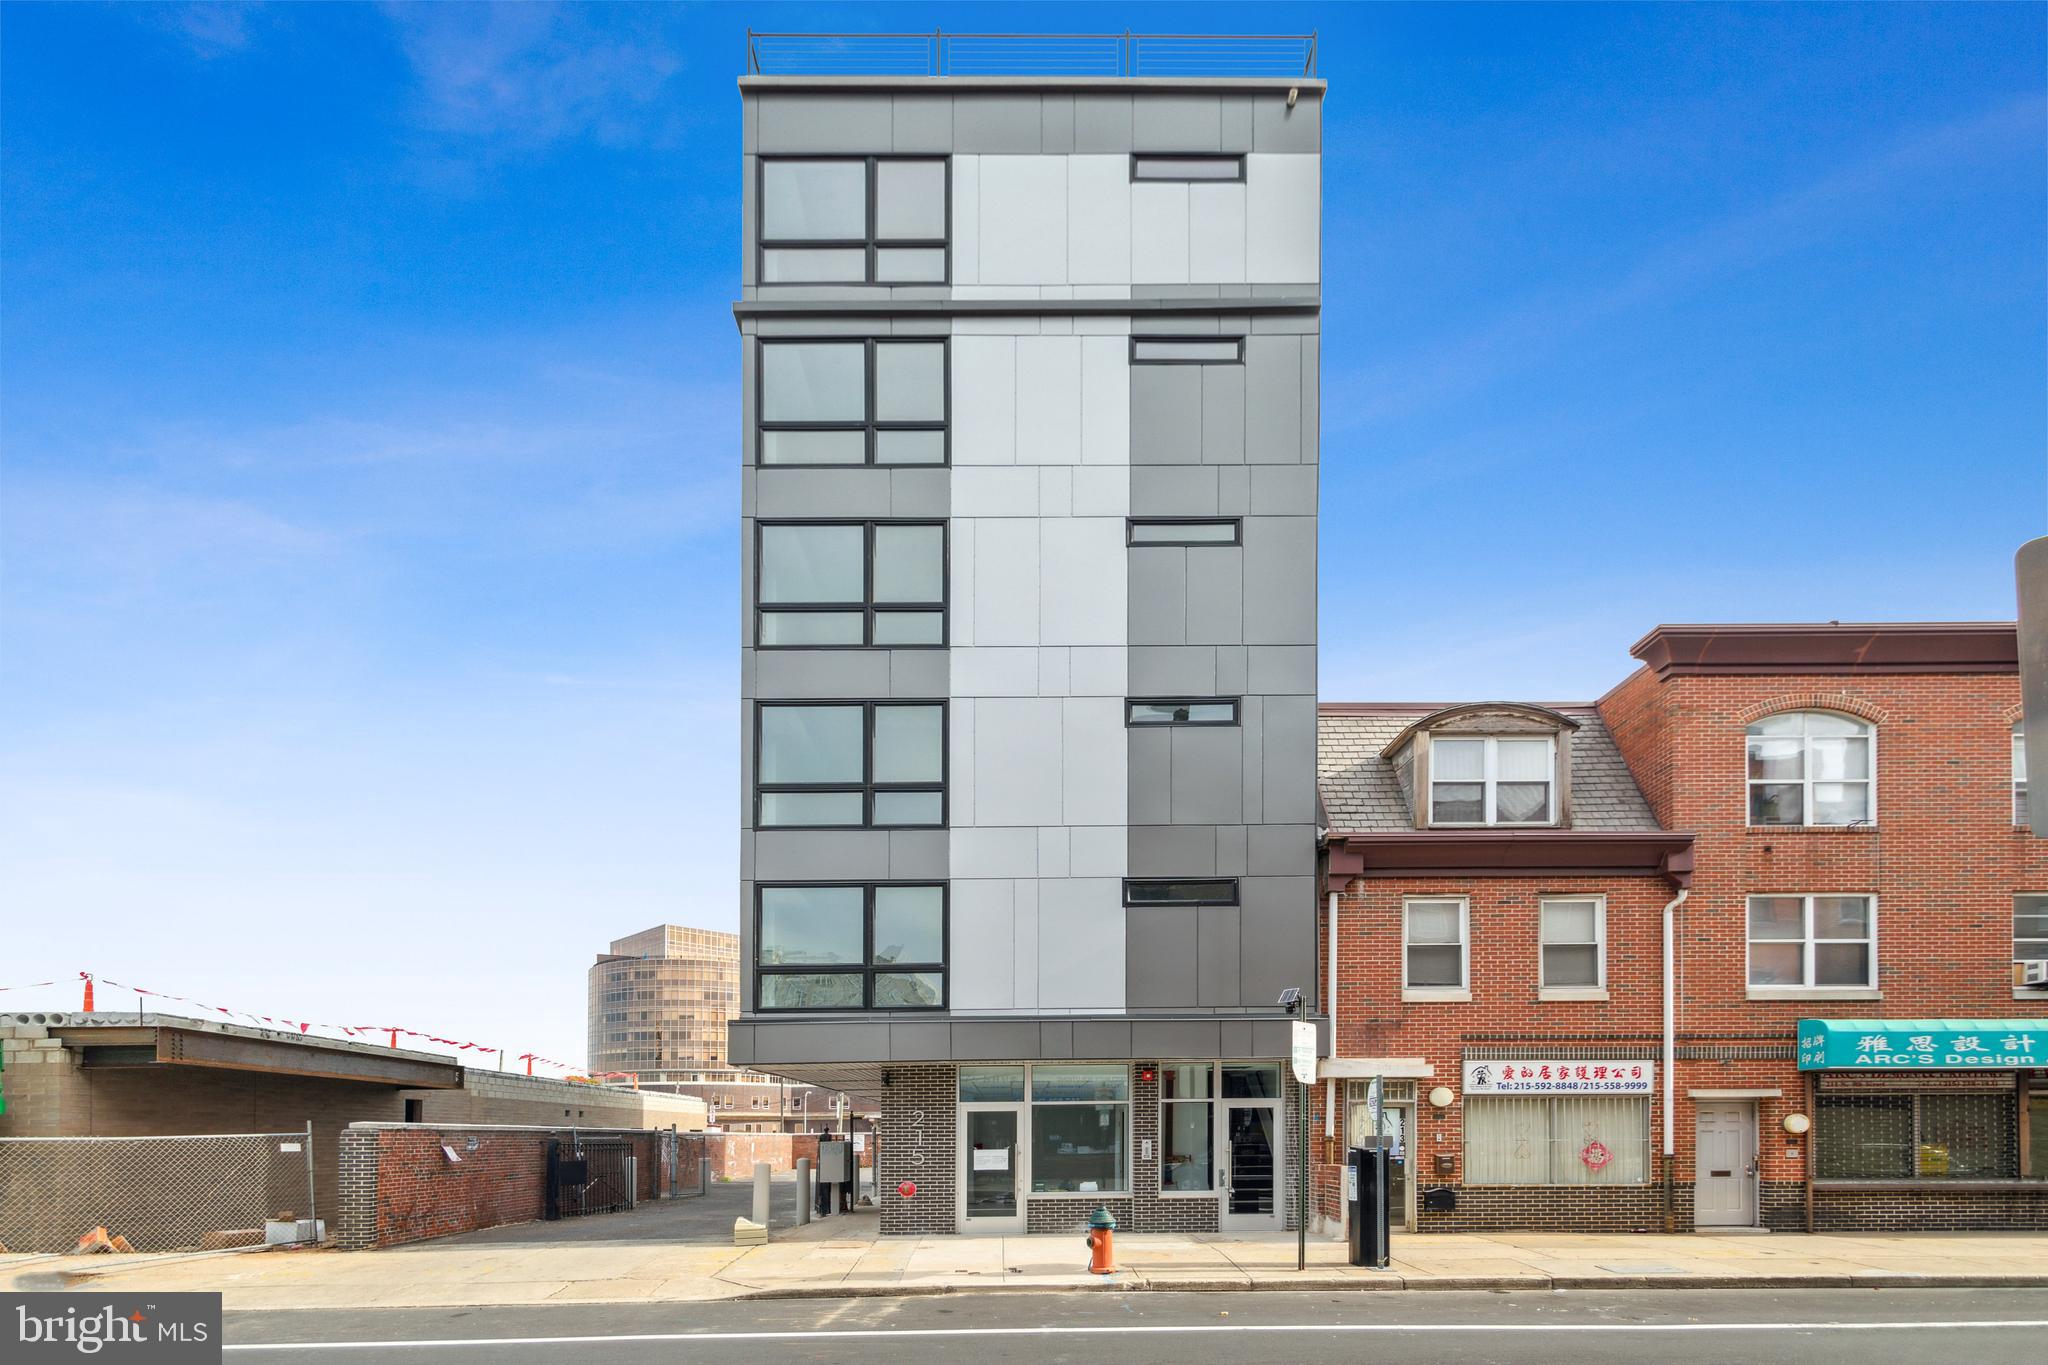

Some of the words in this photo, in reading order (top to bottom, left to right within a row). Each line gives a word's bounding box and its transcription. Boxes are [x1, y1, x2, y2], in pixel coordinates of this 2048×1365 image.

[1945, 1054, 2035, 1065] Design
[1496, 1081, 1513, 1090] Tel:
[911, 1110, 925, 1165] 215
